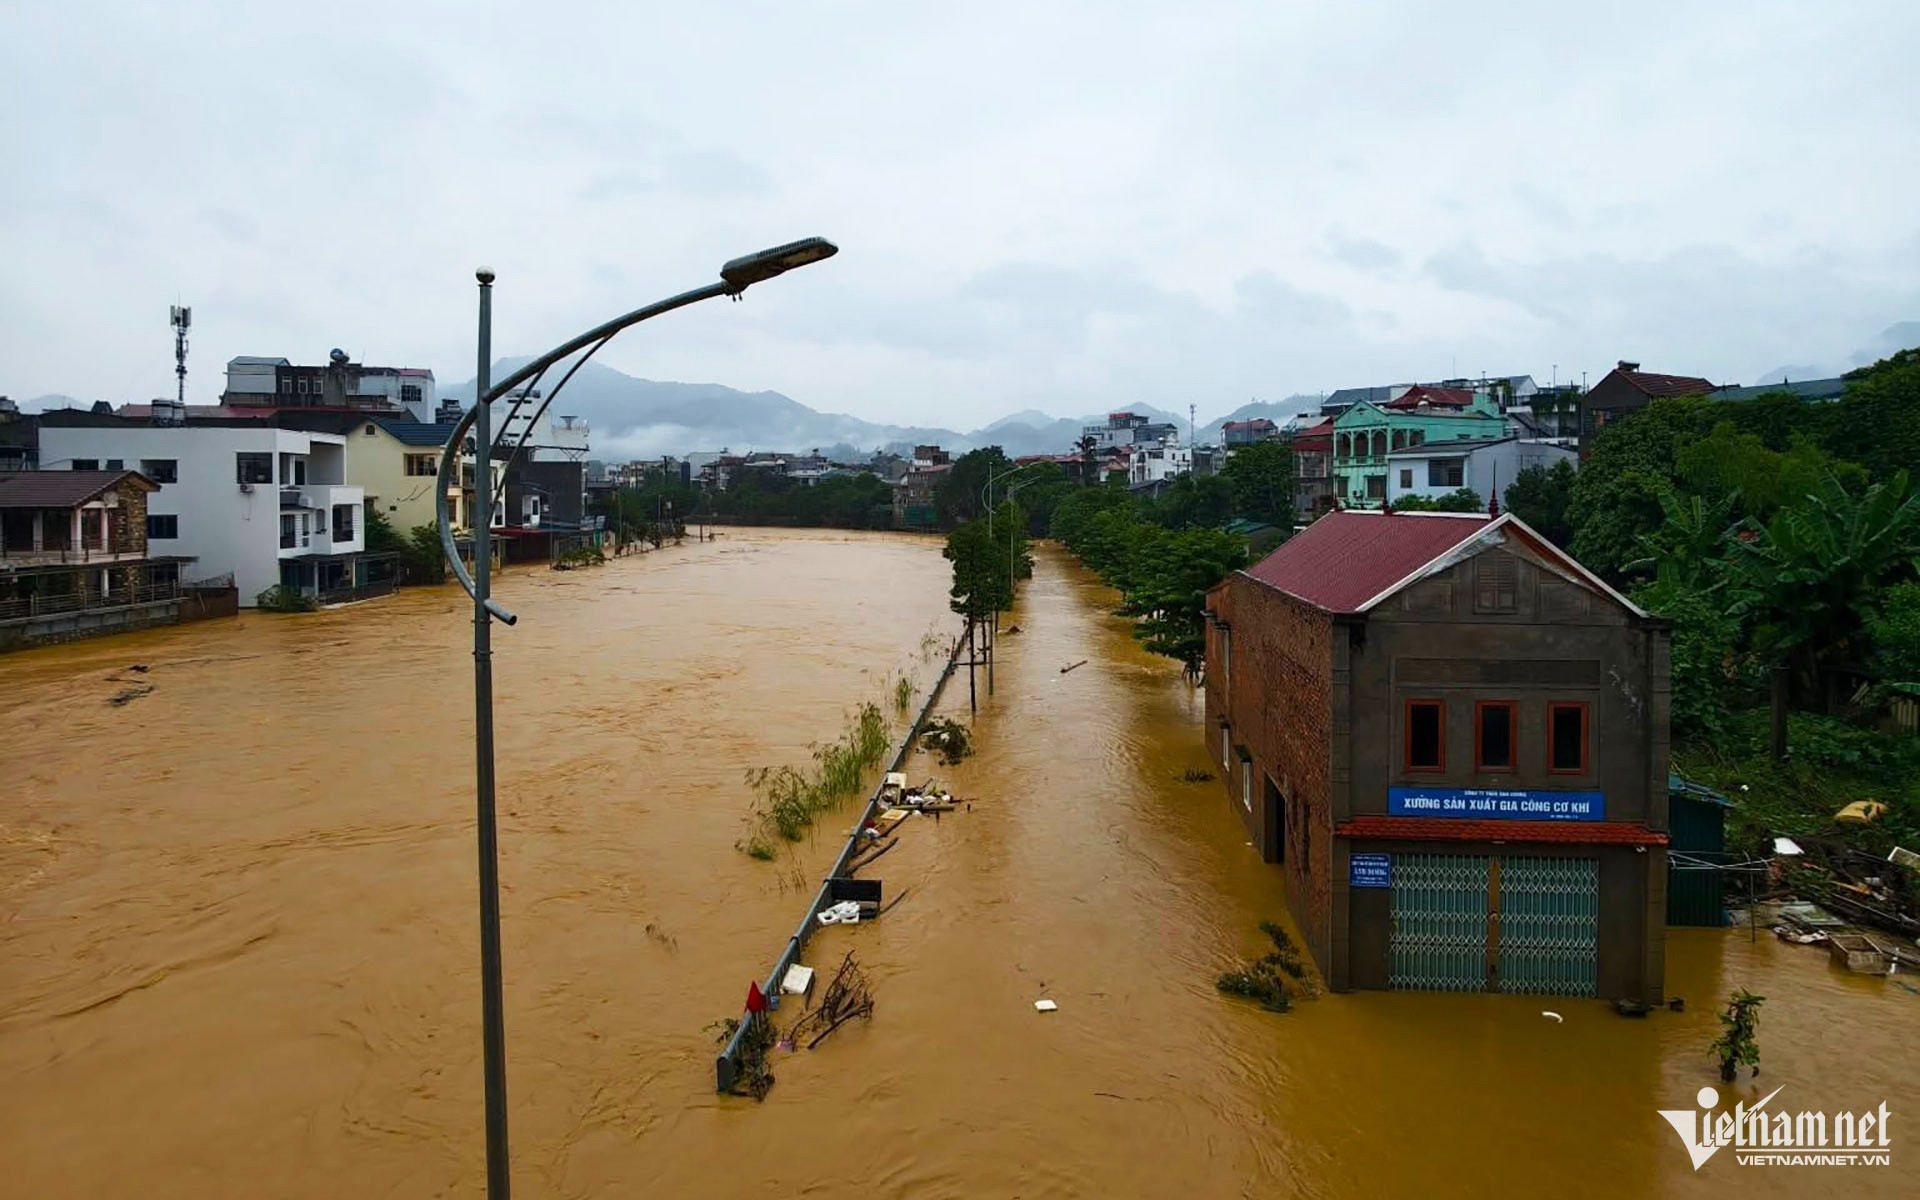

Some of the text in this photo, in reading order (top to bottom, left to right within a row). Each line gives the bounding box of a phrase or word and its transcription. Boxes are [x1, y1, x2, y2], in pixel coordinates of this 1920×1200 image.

[1404, 794, 1590, 813] XƯỞNG SẢN XUẤT GIA CÔNG CƠ KHÍ
